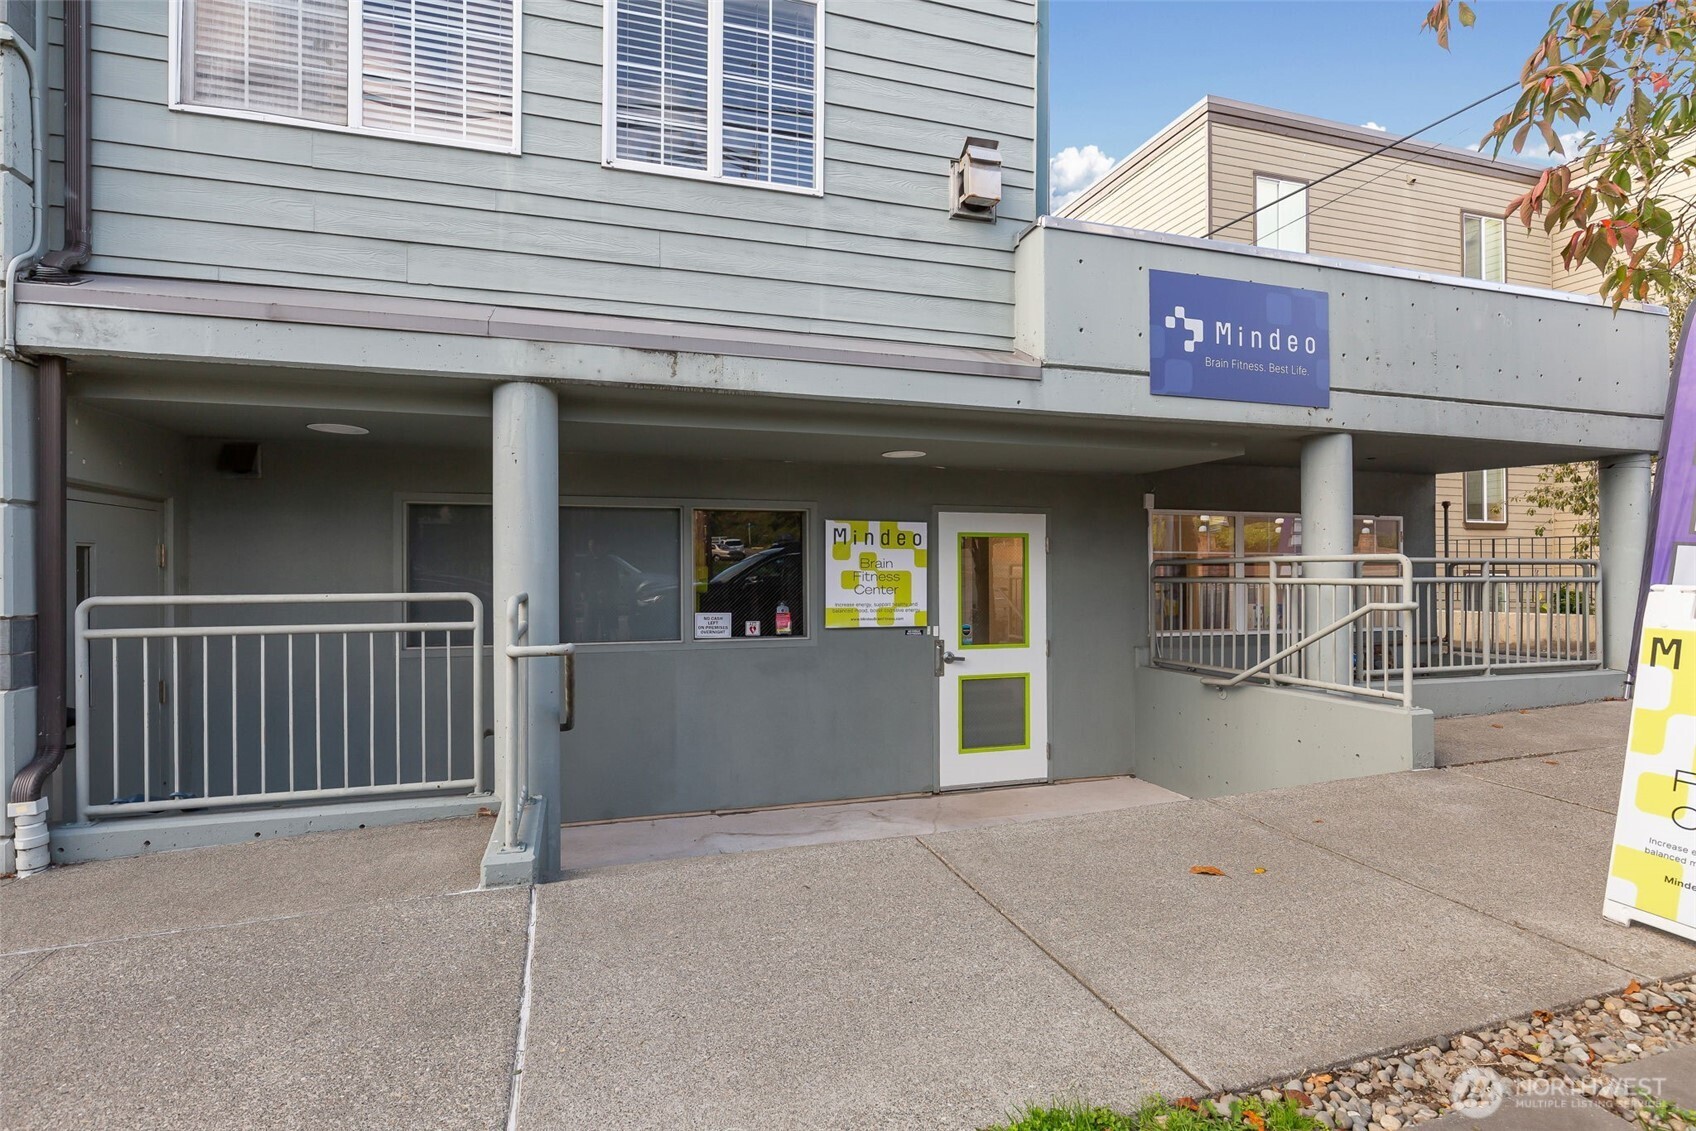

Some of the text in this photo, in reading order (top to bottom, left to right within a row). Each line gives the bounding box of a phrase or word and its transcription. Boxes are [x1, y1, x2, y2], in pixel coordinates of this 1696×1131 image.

[1215, 321, 1316, 354] Mindeo
[1205, 357, 1310, 376] Brain Fitness. Best Life.
[833, 527, 922, 546] Mindeo
[860, 558, 894, 569] Brain
[853, 571, 901, 582] Fitness
[853, 584, 899, 595] Center
[1648, 837, 1689, 854] Increase
[1644, 847, 1687, 864] balanced
